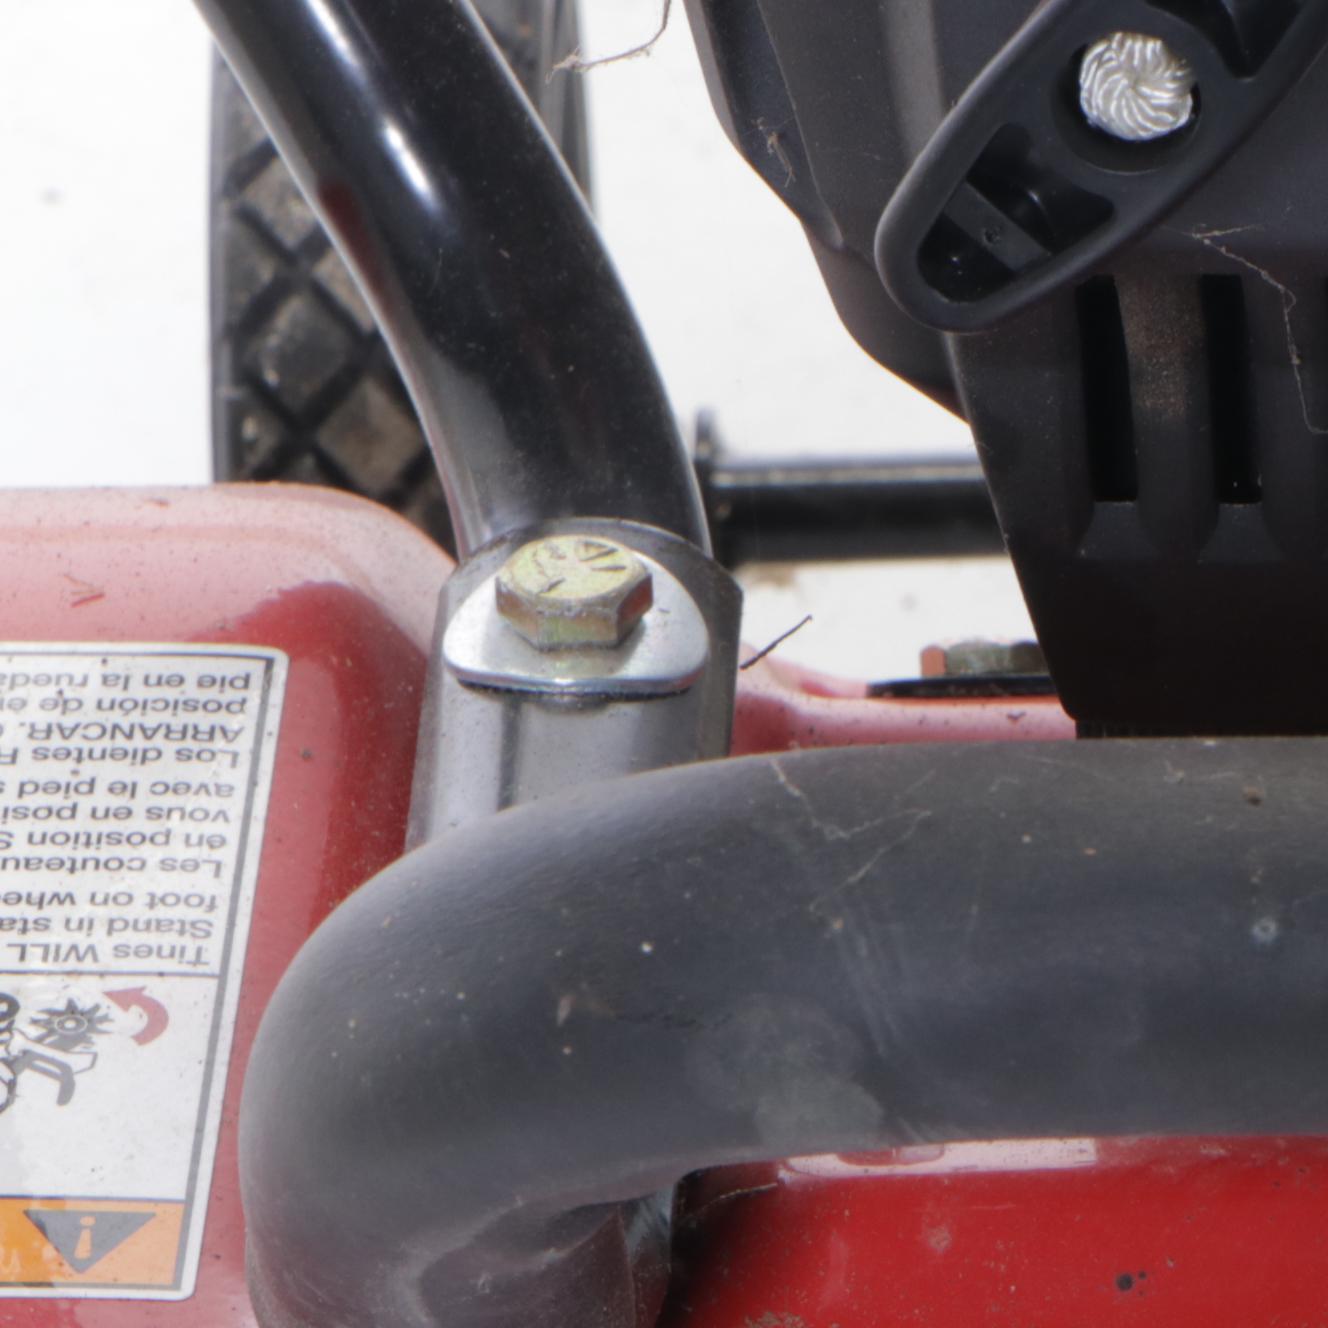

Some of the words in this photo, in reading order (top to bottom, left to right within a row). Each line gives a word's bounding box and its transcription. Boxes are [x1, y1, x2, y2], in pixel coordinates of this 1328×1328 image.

[102, 672, 130, 691] la
[143, 674, 185, 688] en
[197, 673, 250, 690] pie
[39, 697, 83, 714] de
[96, 697, 248, 715] posición
[19, 721, 245, 743] ARRANCAR.
[31, 746, 162, 765] dientes
[175, 748, 240, 769] Los
[17, 776, 96, 799] pied
[108, 780, 138, 799] le
[150, 779, 236, 798] avec
[2, 802, 78, 824] posi
[90, 804, 134, 819] en
[145, 805, 231, 824] vous
[27, 828, 171, 850] position
[159, 857, 223, 879] Les
[90, 891, 134, 906] on
[146, 891, 219, 913] foot
[64, 917, 94, 937] in
[106, 916, 215, 939] Stand
[6, 942, 99, 965] WILL
[112, 943, 211, 968] Tines
